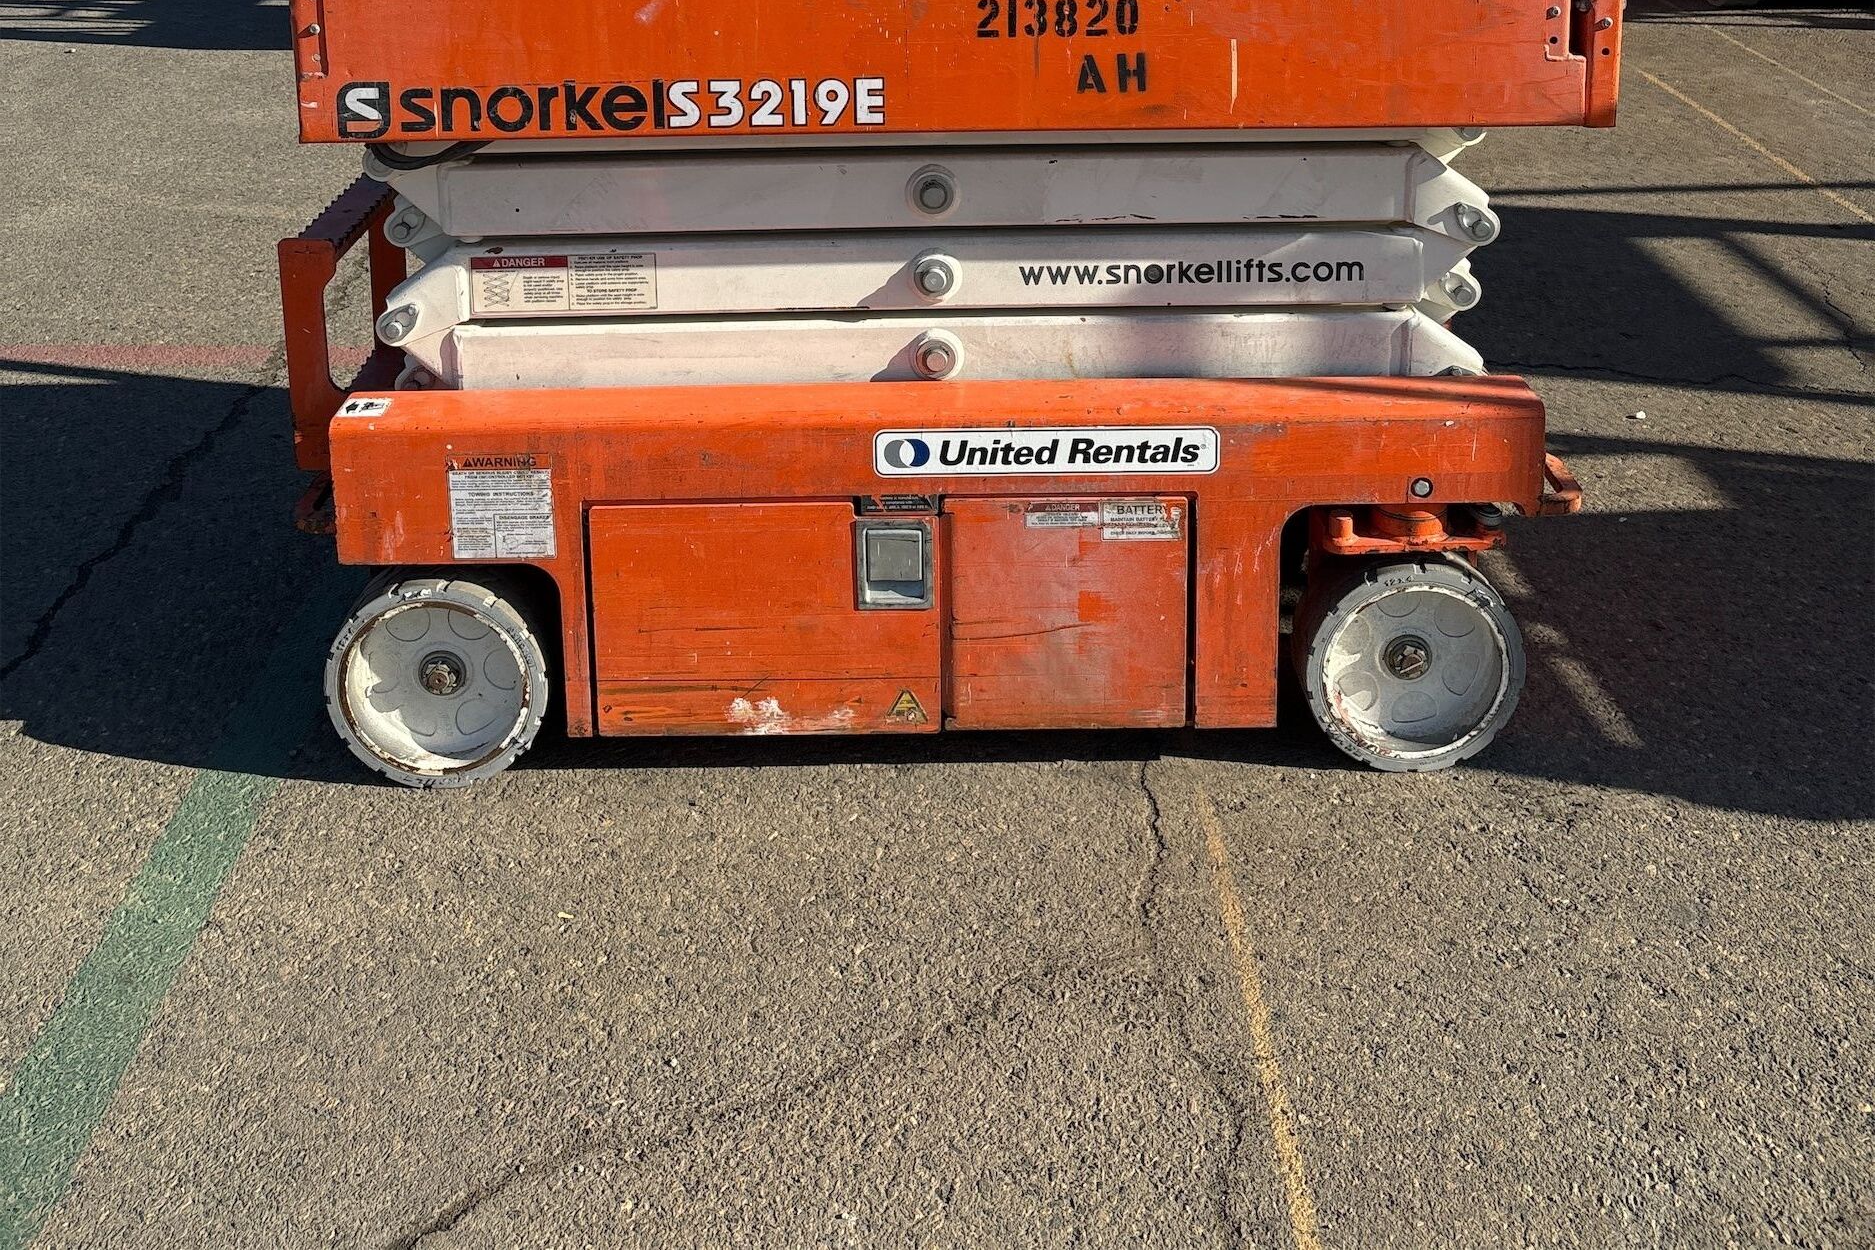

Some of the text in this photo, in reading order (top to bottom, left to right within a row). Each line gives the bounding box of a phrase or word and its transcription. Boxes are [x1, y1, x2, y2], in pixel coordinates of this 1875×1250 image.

[400, 79, 666, 132] snorkel
[666, 77, 885, 129] S3219E
[502, 258, 545, 267] DANGER
[1019, 260, 1365, 285] www.snorkellifts.com
[472, 457, 537, 467] WARNING
[939, 437, 1200, 466] United Rentals
